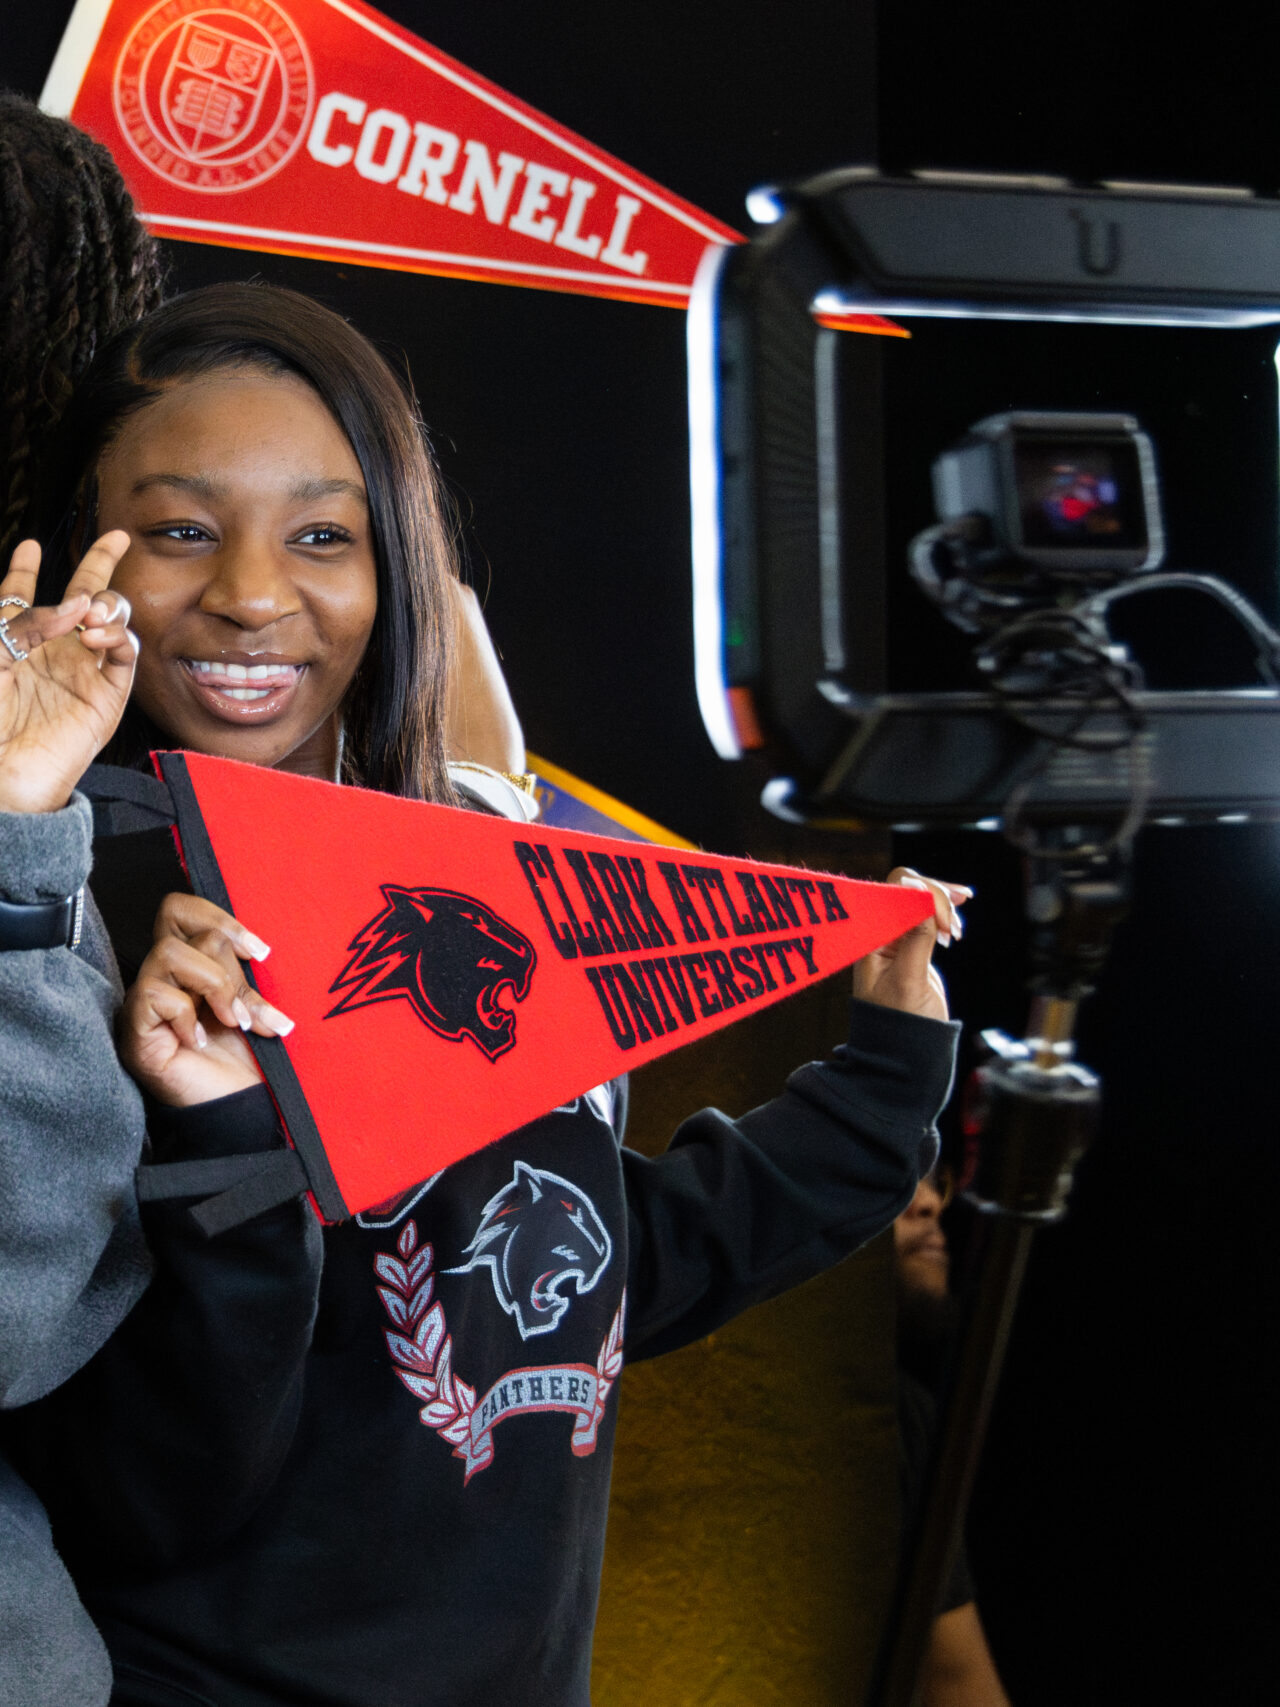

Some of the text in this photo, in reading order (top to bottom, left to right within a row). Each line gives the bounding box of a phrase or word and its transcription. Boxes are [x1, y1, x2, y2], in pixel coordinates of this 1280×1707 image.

[307, 92, 648, 275] CORNELL
[513, 841, 850, 959] CLARK ATLANTA
[585, 936, 819, 1050] UNIVERSITY
[482, 1376, 590, 1427] PANTHERS
